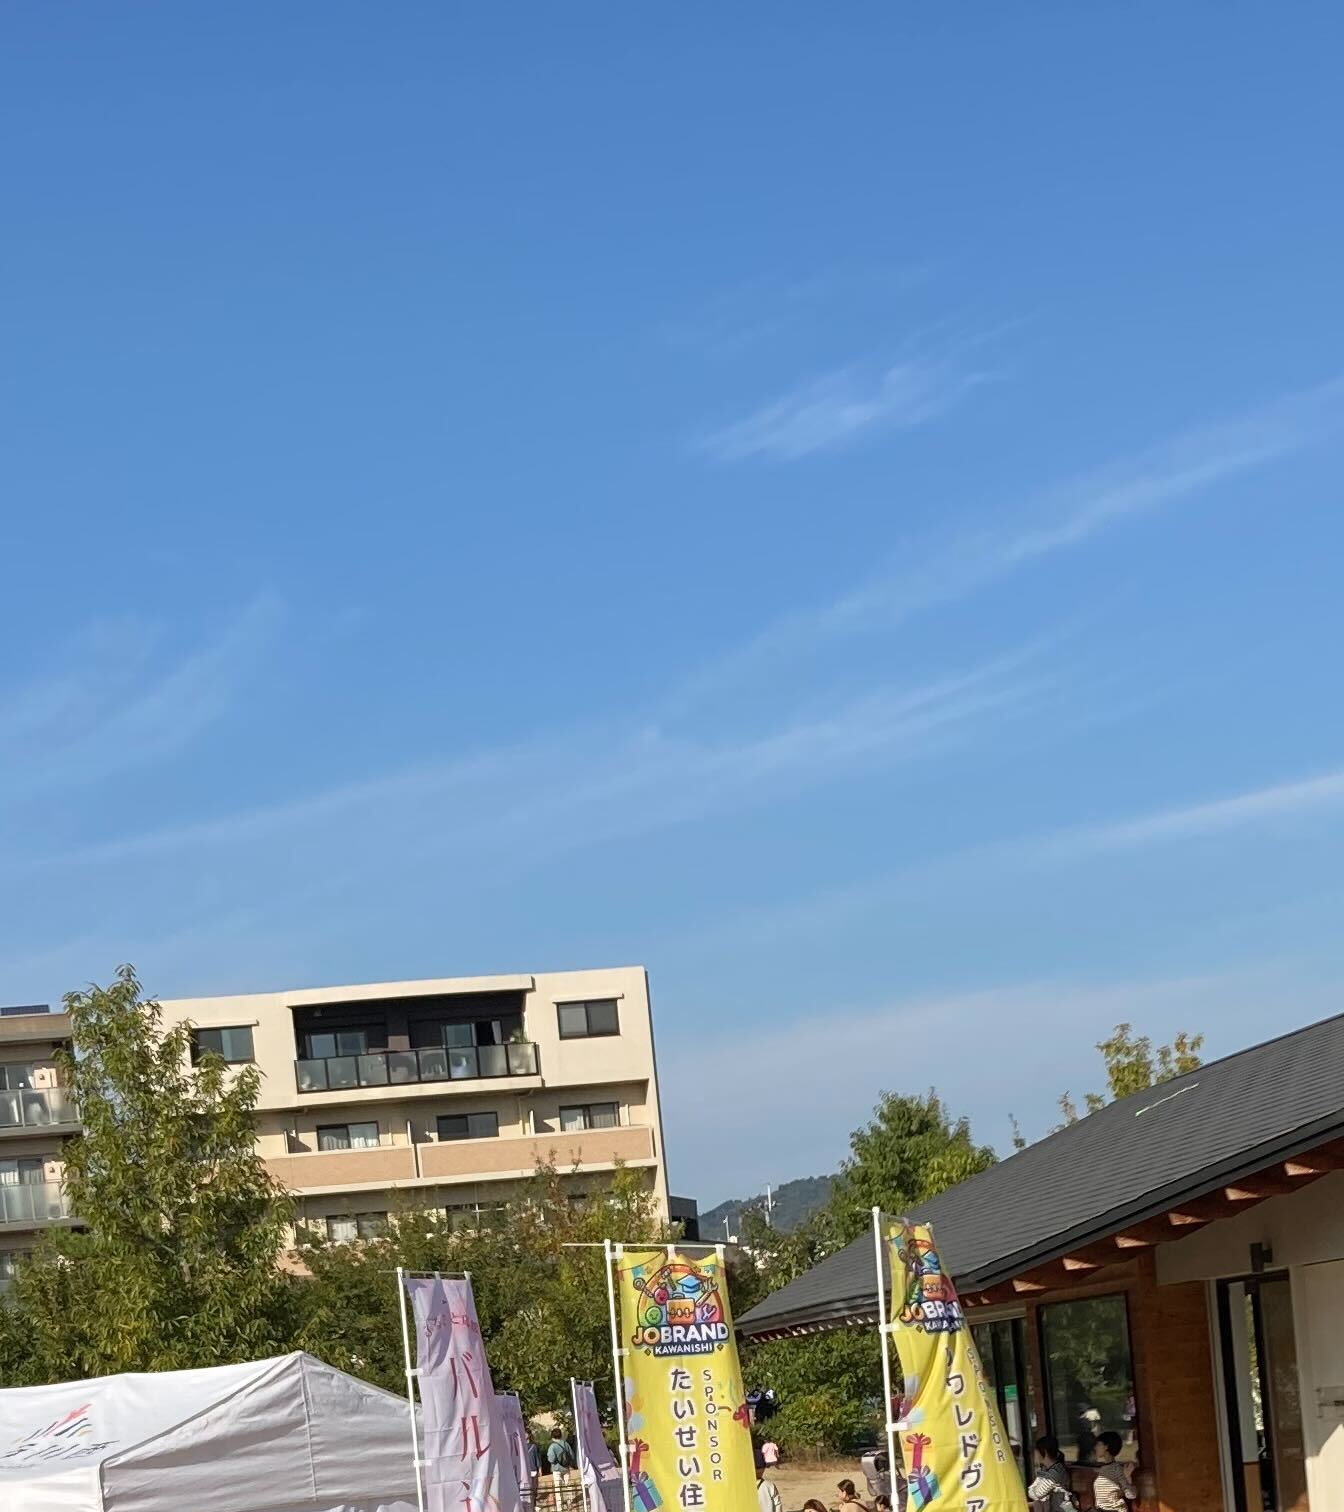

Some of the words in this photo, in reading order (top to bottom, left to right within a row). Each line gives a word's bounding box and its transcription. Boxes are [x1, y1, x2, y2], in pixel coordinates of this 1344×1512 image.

[632, 1322, 729, 1345] JOBRAND
[655, 1343, 713, 1355] KAWANISHI
[702, 1369, 723, 1481] SPONSOR
